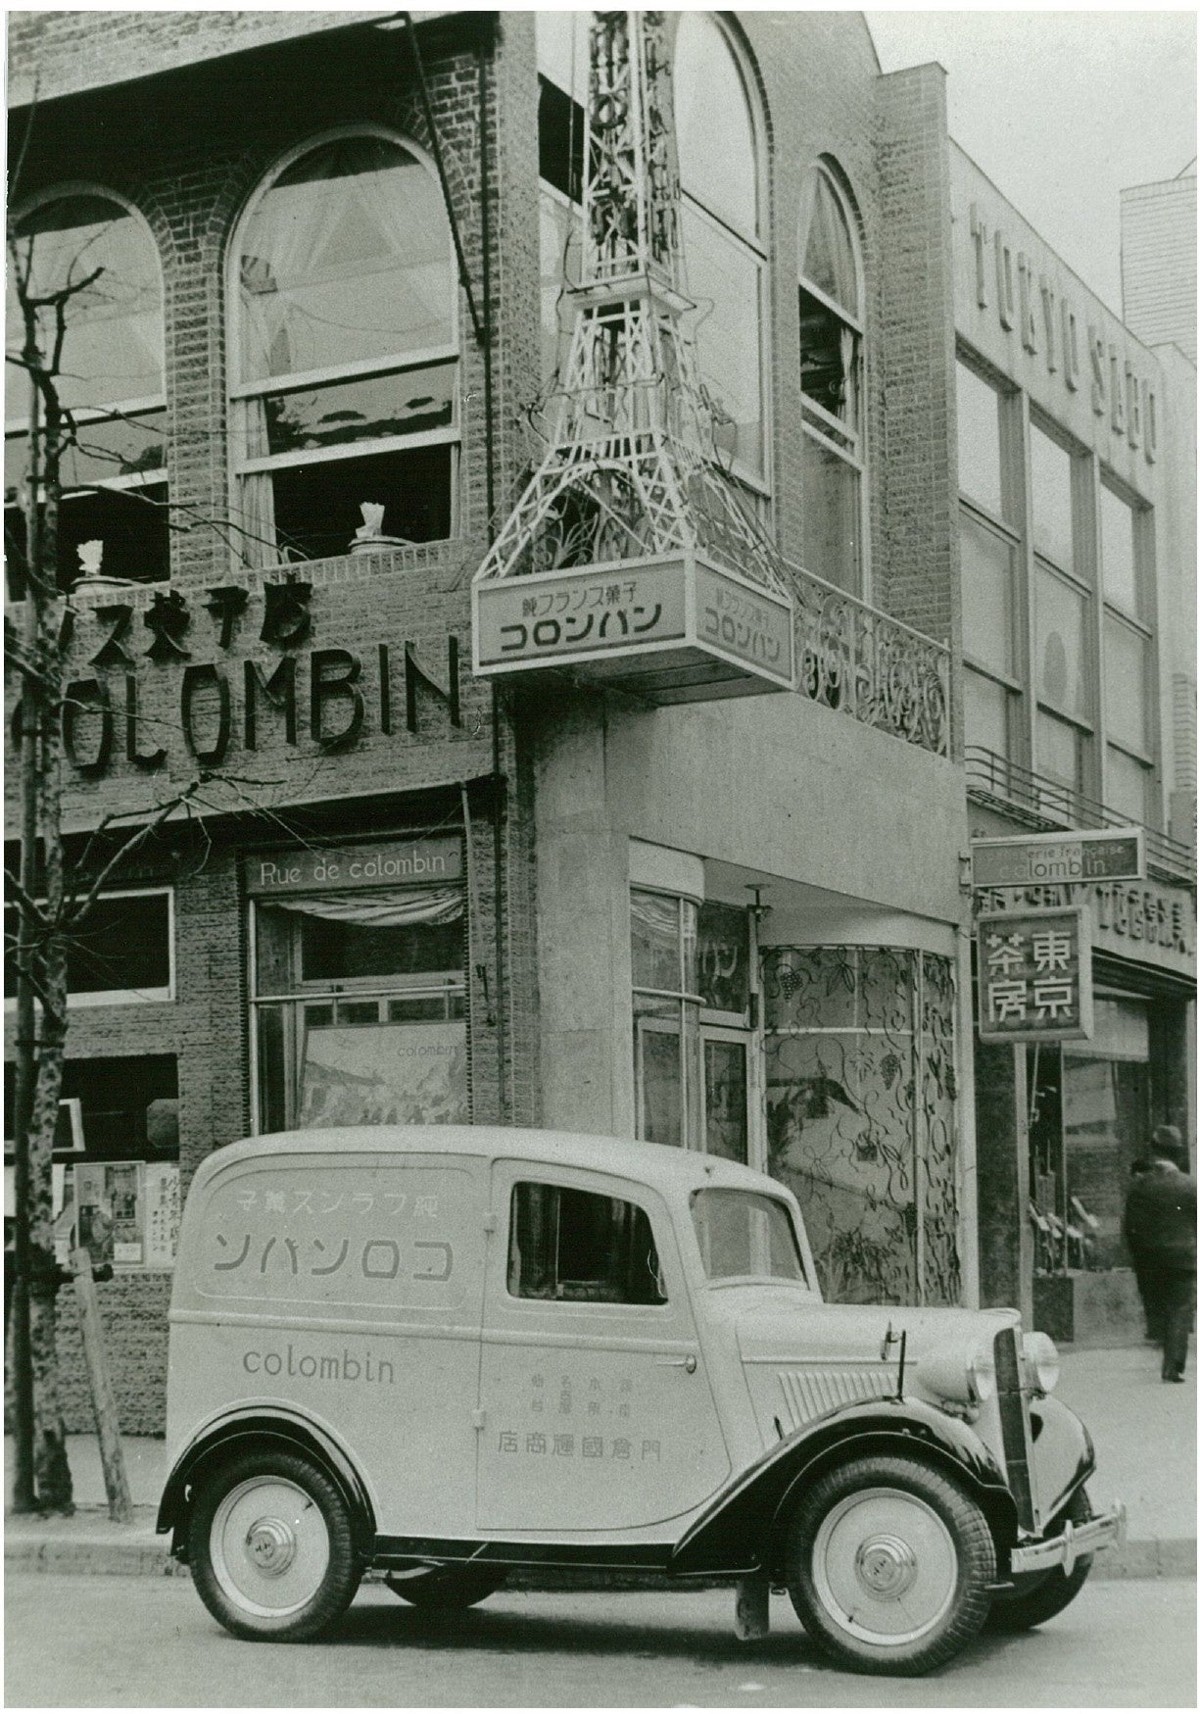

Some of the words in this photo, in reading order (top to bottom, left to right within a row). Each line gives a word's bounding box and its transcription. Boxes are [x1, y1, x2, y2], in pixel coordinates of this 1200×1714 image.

[260, 862, 301, 885] Rue
[314, 860, 340, 882] de
[349, 853, 446, 879] colombin
[243, 1344, 395, 1384] colombin
